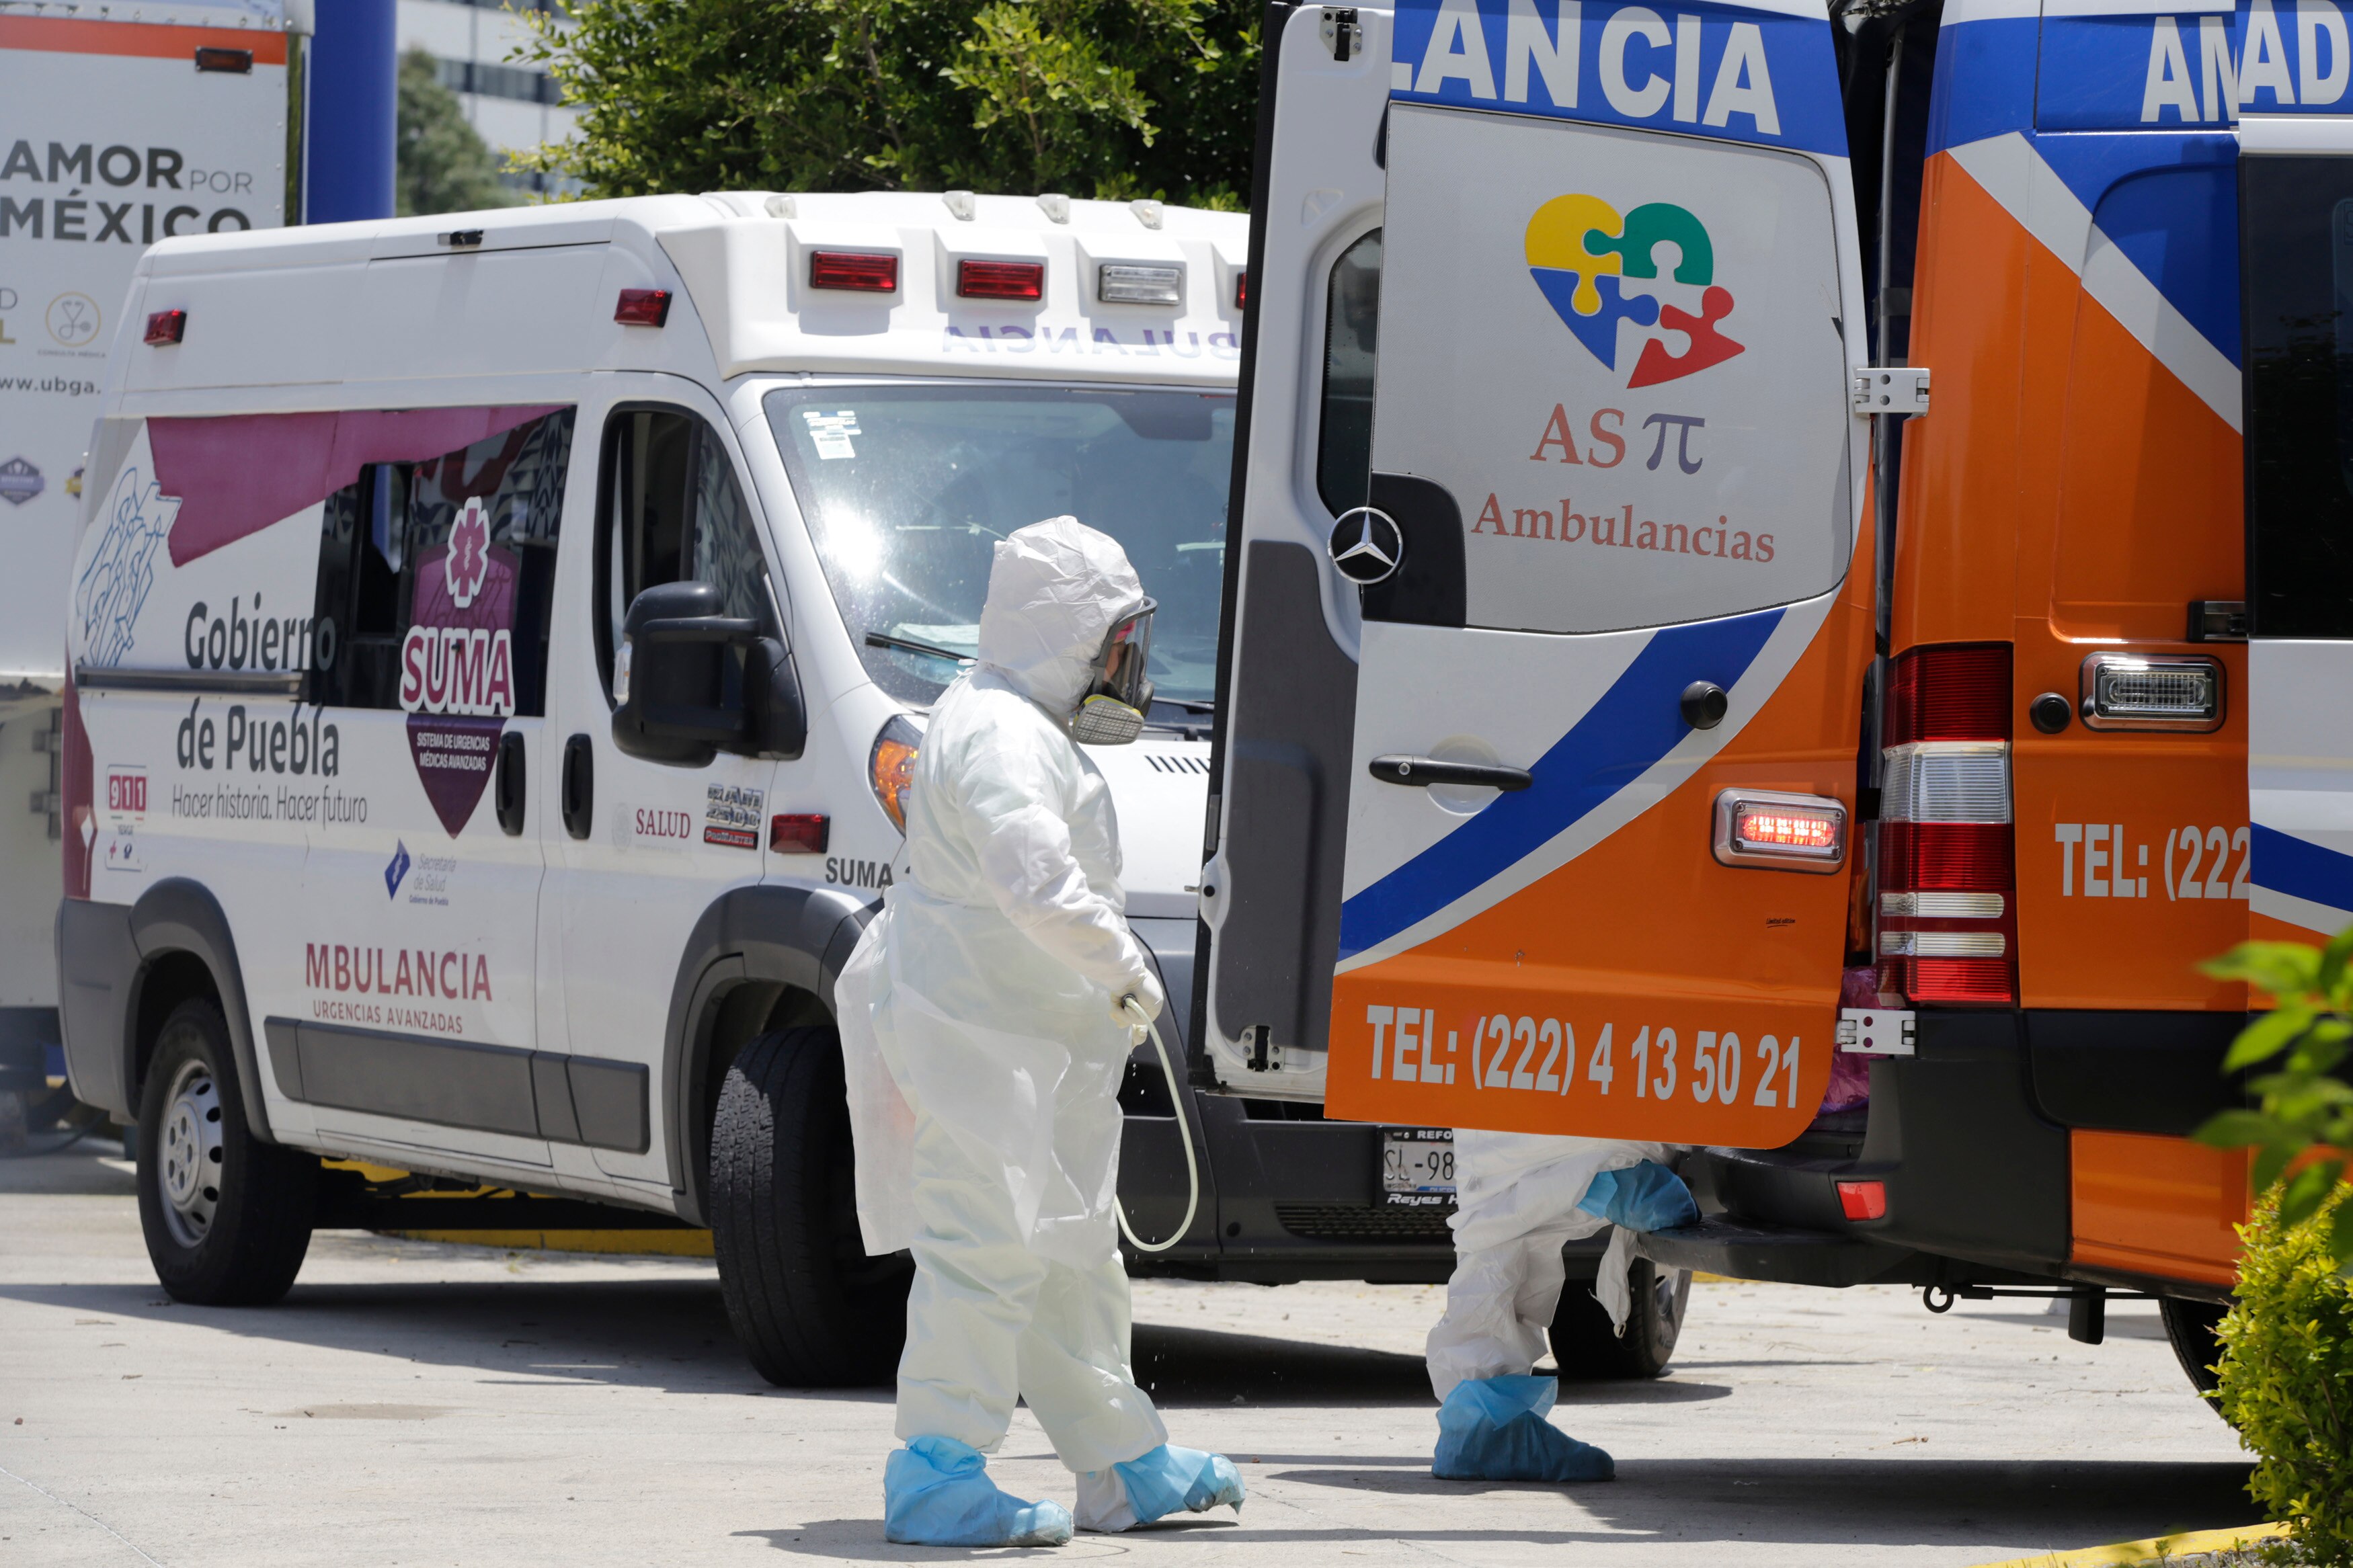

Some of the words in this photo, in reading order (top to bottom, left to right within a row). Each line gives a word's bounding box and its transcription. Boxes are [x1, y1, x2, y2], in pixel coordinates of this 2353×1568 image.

[0, 140, 183, 190] AMOR
[190, 170, 252, 195] POR
[0, 189, 251, 245] MÉXICO
[1529, 403, 1626, 468] AS
[1470, 493, 1775, 563] Ambulancias
[185, 591, 335, 671] Gobierno
[402, 632, 512, 710] SUMA
[177, 696, 214, 770] de
[226, 700, 339, 777] Puebla
[417, 732, 444, 747] SISTEMA
[444, 734, 453, 749] DE
[453, 735, 490, 751] URGENCIAS
[420, 750, 448, 768] MÉDICAS
[448, 754, 487, 771] AVANZADAS
[110, 777, 146, 810] 911
[172, 783, 214, 818] Hacer
[216, 782, 272, 820] historia.
[276, 784, 319, 821] Hacer
[323, 784, 368, 831] futuro
[706, 804, 762, 829] 2500
[708, 783, 764, 809] RAM
[636, 809, 690, 839] SALUD
[413, 873, 424, 891] de
[425, 873, 448, 893] Salud
[826, 857, 893, 889] SUMA
[2055, 823, 2148, 898] TEL:
[2164, 825, 2250, 901] (222
[306, 943, 492, 1001] MBULANCIA
[313, 1000, 381, 1023] URGENCIAS
[387, 1008, 463, 1034] AVANZADAS
[1367, 1005, 1458, 1085] TEL:
[1472, 1014, 1575, 1096] (222)
[1588, 1022, 1613, 1095] 4
[1631, 1026, 1677, 1101] 13
[1691, 1030, 1741, 1105] 50
[1754, 1034, 1800, 1109] 21
